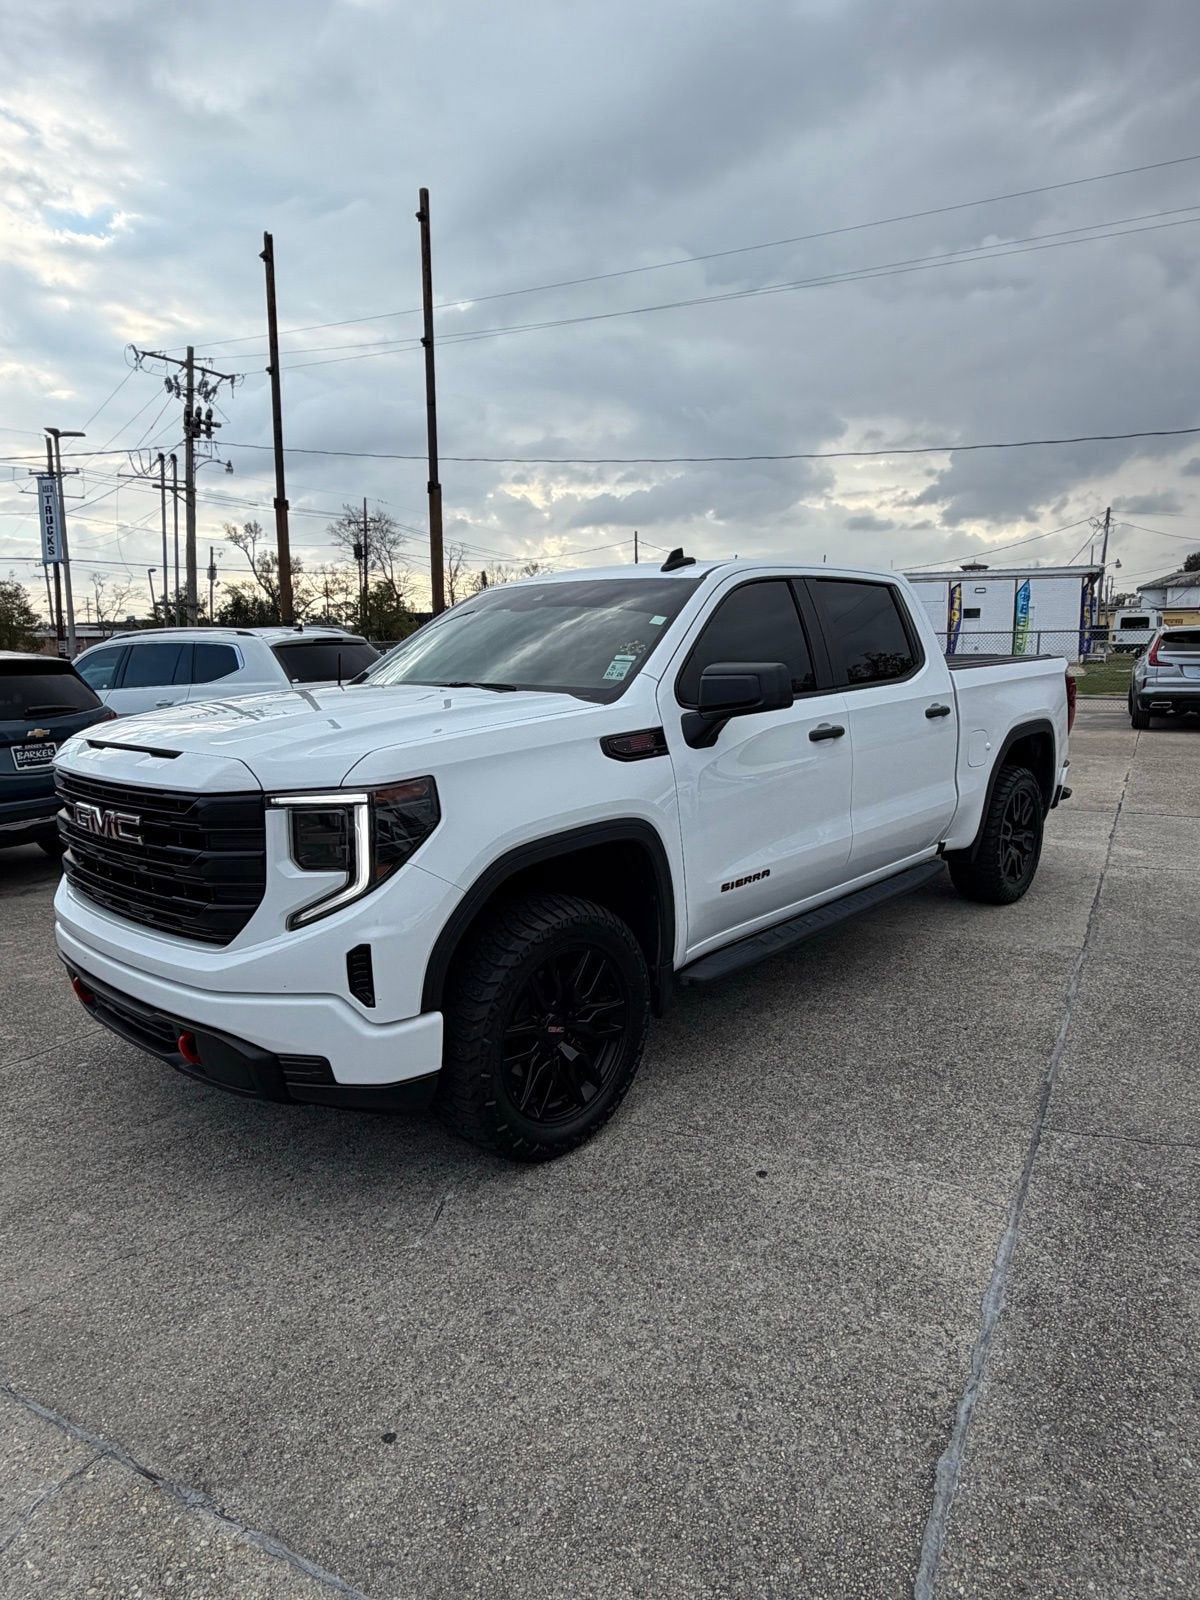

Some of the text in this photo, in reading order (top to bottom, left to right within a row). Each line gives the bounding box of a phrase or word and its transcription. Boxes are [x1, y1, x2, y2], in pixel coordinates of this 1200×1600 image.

[44, 495, 56, 556] TRUCKS
[16, 749, 54, 760] BARKER
[74, 801, 144, 846] GMC
[720, 868, 771, 893] SIERRA
